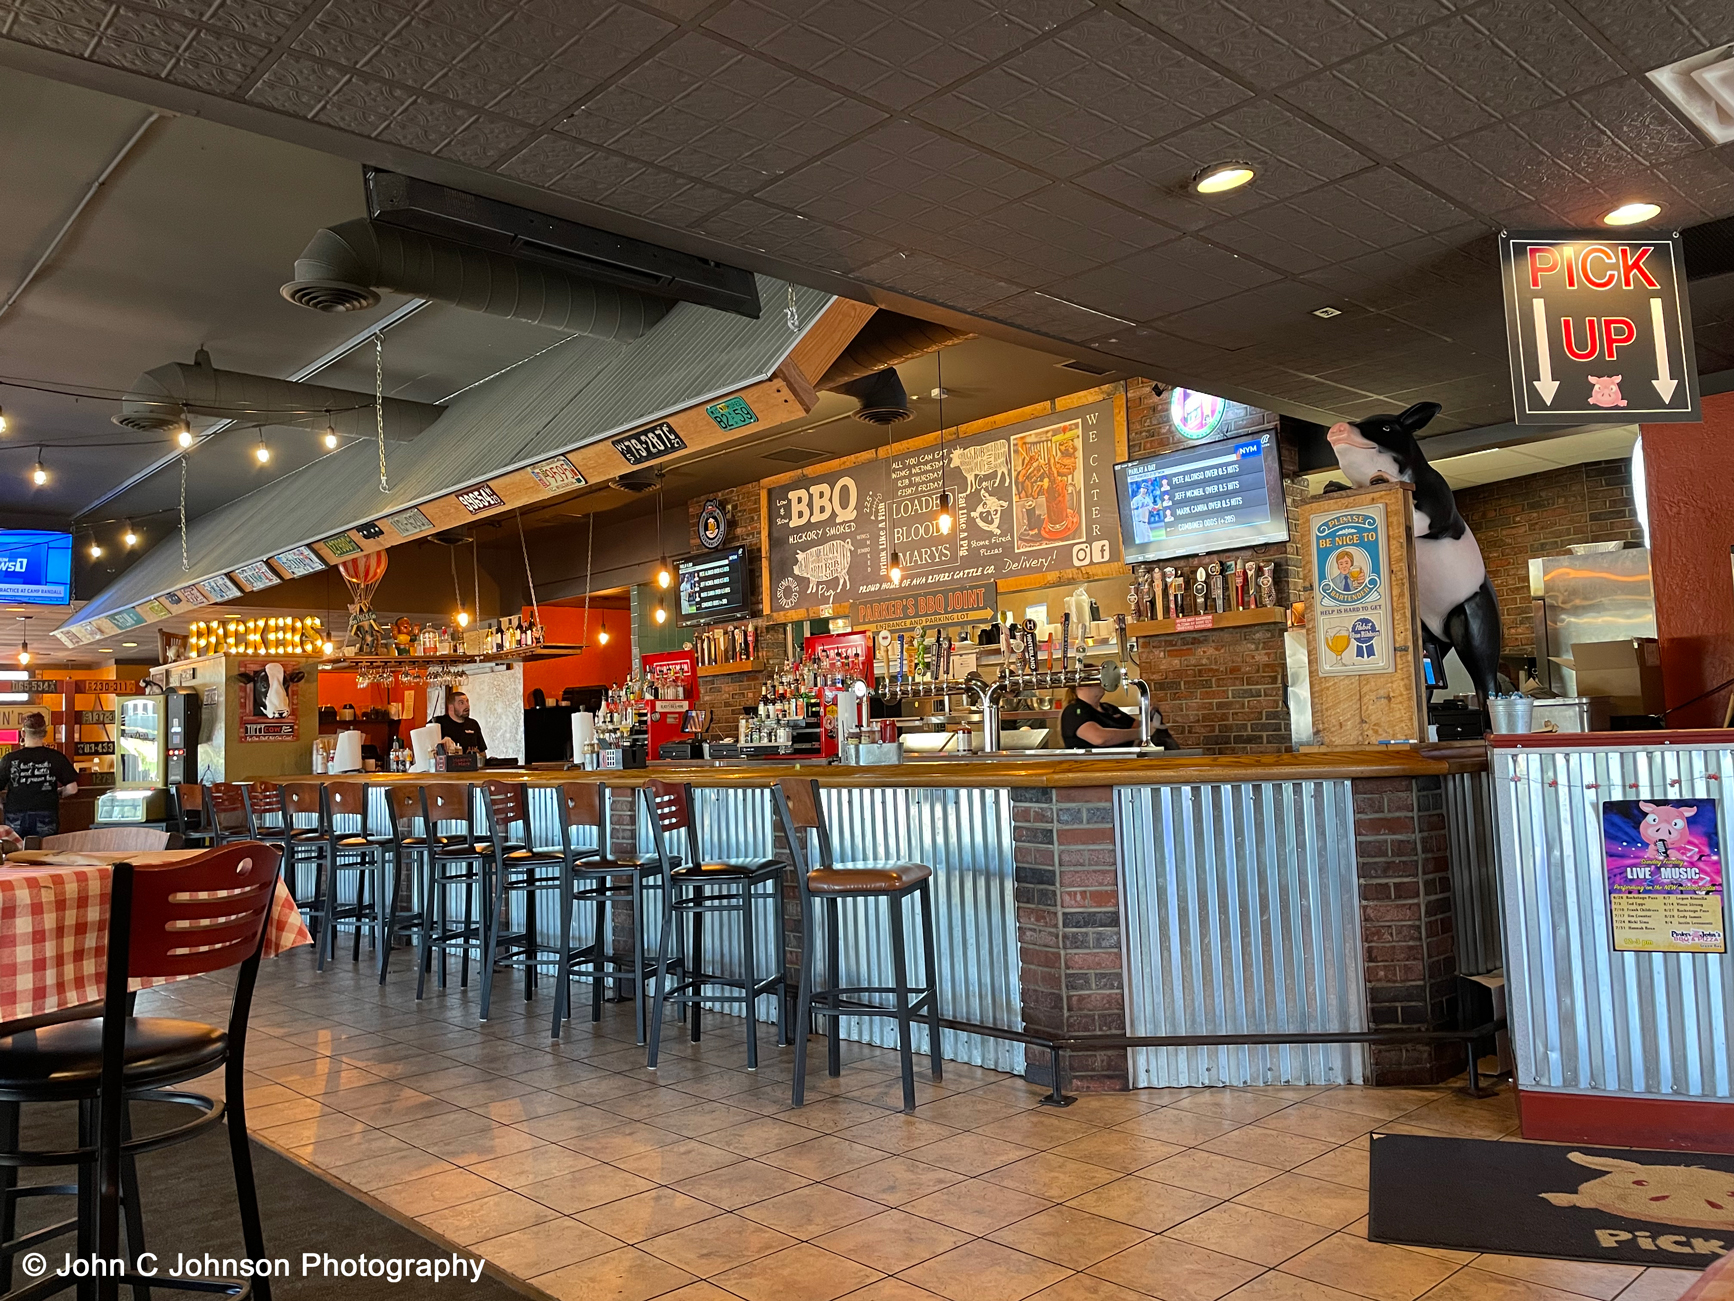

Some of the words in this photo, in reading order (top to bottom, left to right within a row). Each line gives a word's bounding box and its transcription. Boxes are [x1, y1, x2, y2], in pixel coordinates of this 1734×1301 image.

[1527, 245, 1661, 291] PICK
[1561, 316, 1637, 361] UP
[1239, 444, 1257, 454] NYM
[905, 457, 918, 465] YOU
[920, 453, 932, 462] CAN
[892, 468, 910, 479] WING
[911, 459, 948, 474] WEDNESDAY
[898, 479, 910, 487] RIB
[912, 470, 943, 484] THURSDAY
[918, 480, 943, 493] FRIDAY
[1089, 454, 1101, 536] CATER
[788, 476, 858, 528] BBQ
[1328, 515, 1365, 528] PLEASE
[789, 529, 822, 544] HICKORY
[826, 523, 856, 537] SMOKED
[991, 533, 1012, 544] Fired
[1320, 538, 1332, 548] BE
[1335, 534, 1360, 546] NICE
[1362, 532, 1376, 542] TO
[899, 544, 951, 568] MARYS
[1002, 550, 1057, 573] Delivery!
[859, 584, 880, 593] PROUD
[911, 577, 927, 586] AVA
[927, 571, 953, 584] RIVERS
[954, 567, 982, 579] CATTLE
[984, 565, 996, 574] CO.
[1330, 587, 1370, 602] BARTENDER
[859, 598, 916, 623] PARKER'S
[918, 593, 944, 615] BBQ
[948, 588, 985, 611] JOINT
[1343, 606, 1360, 614] HARD
[875, 619, 908, 631] ENTRANCE
[909, 618, 923, 626] AND
[925, 614, 955, 625] PARKING
[956, 612, 970, 620] LOT
[189, 615, 325, 658] PACKERS
[1626, 867, 1651, 879] LIVE
[1661, 867, 1699, 879] MUSIC
